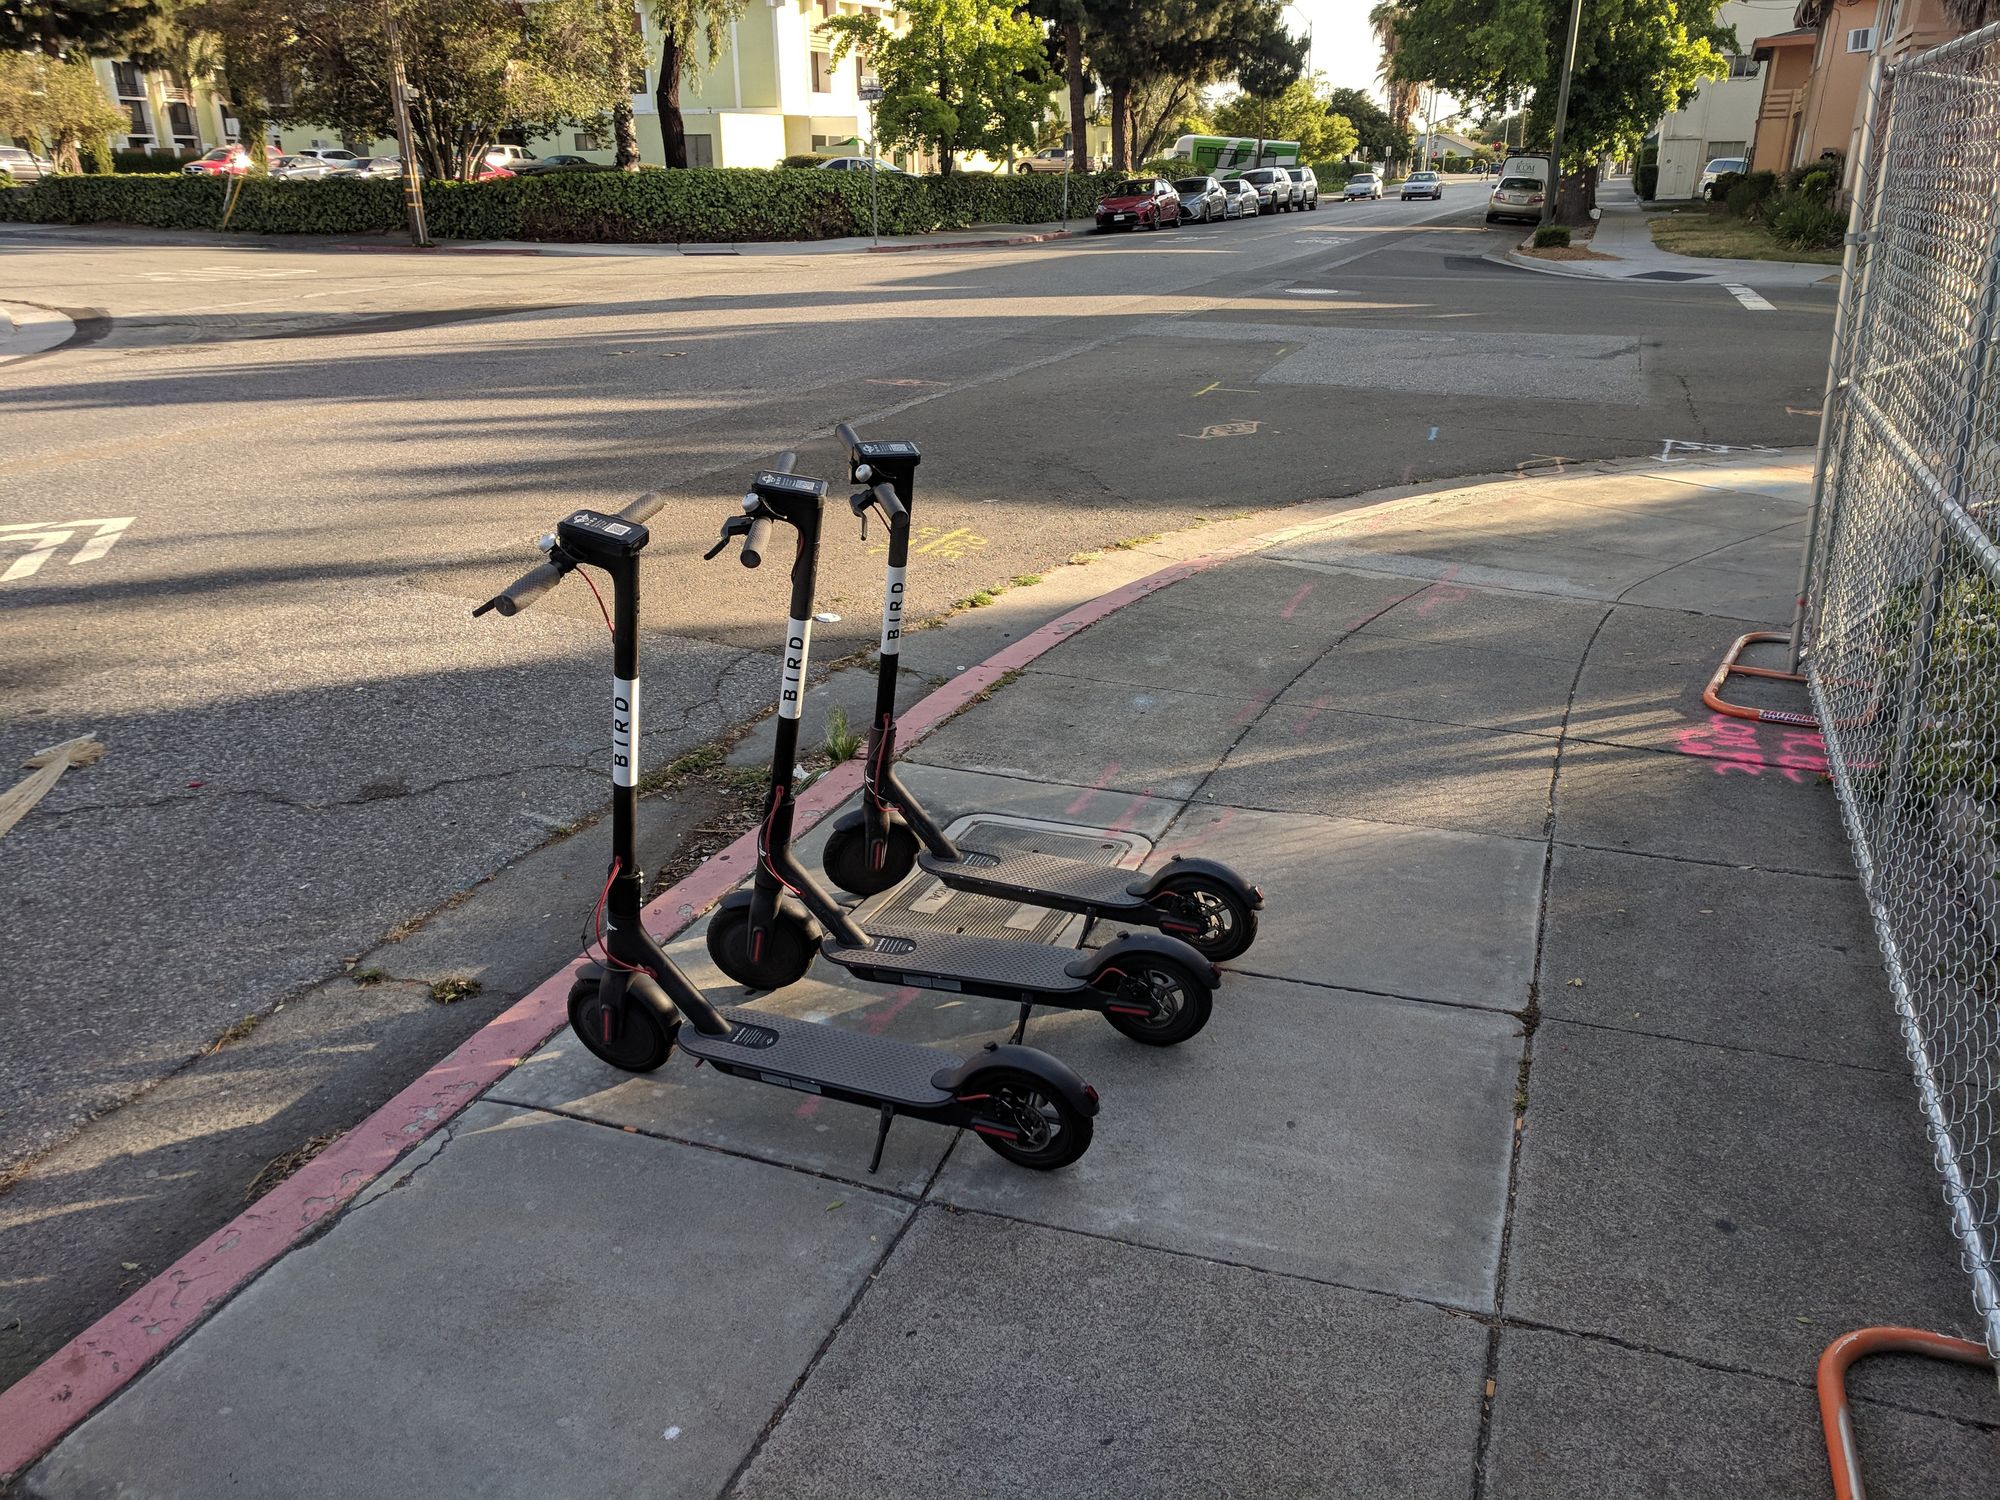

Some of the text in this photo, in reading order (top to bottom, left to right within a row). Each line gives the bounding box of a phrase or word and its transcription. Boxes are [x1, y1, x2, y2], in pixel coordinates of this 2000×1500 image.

[887, 582, 904, 640] BIRD
[783, 636, 804, 701] BIRD
[614, 696, 629, 767] BIRD
